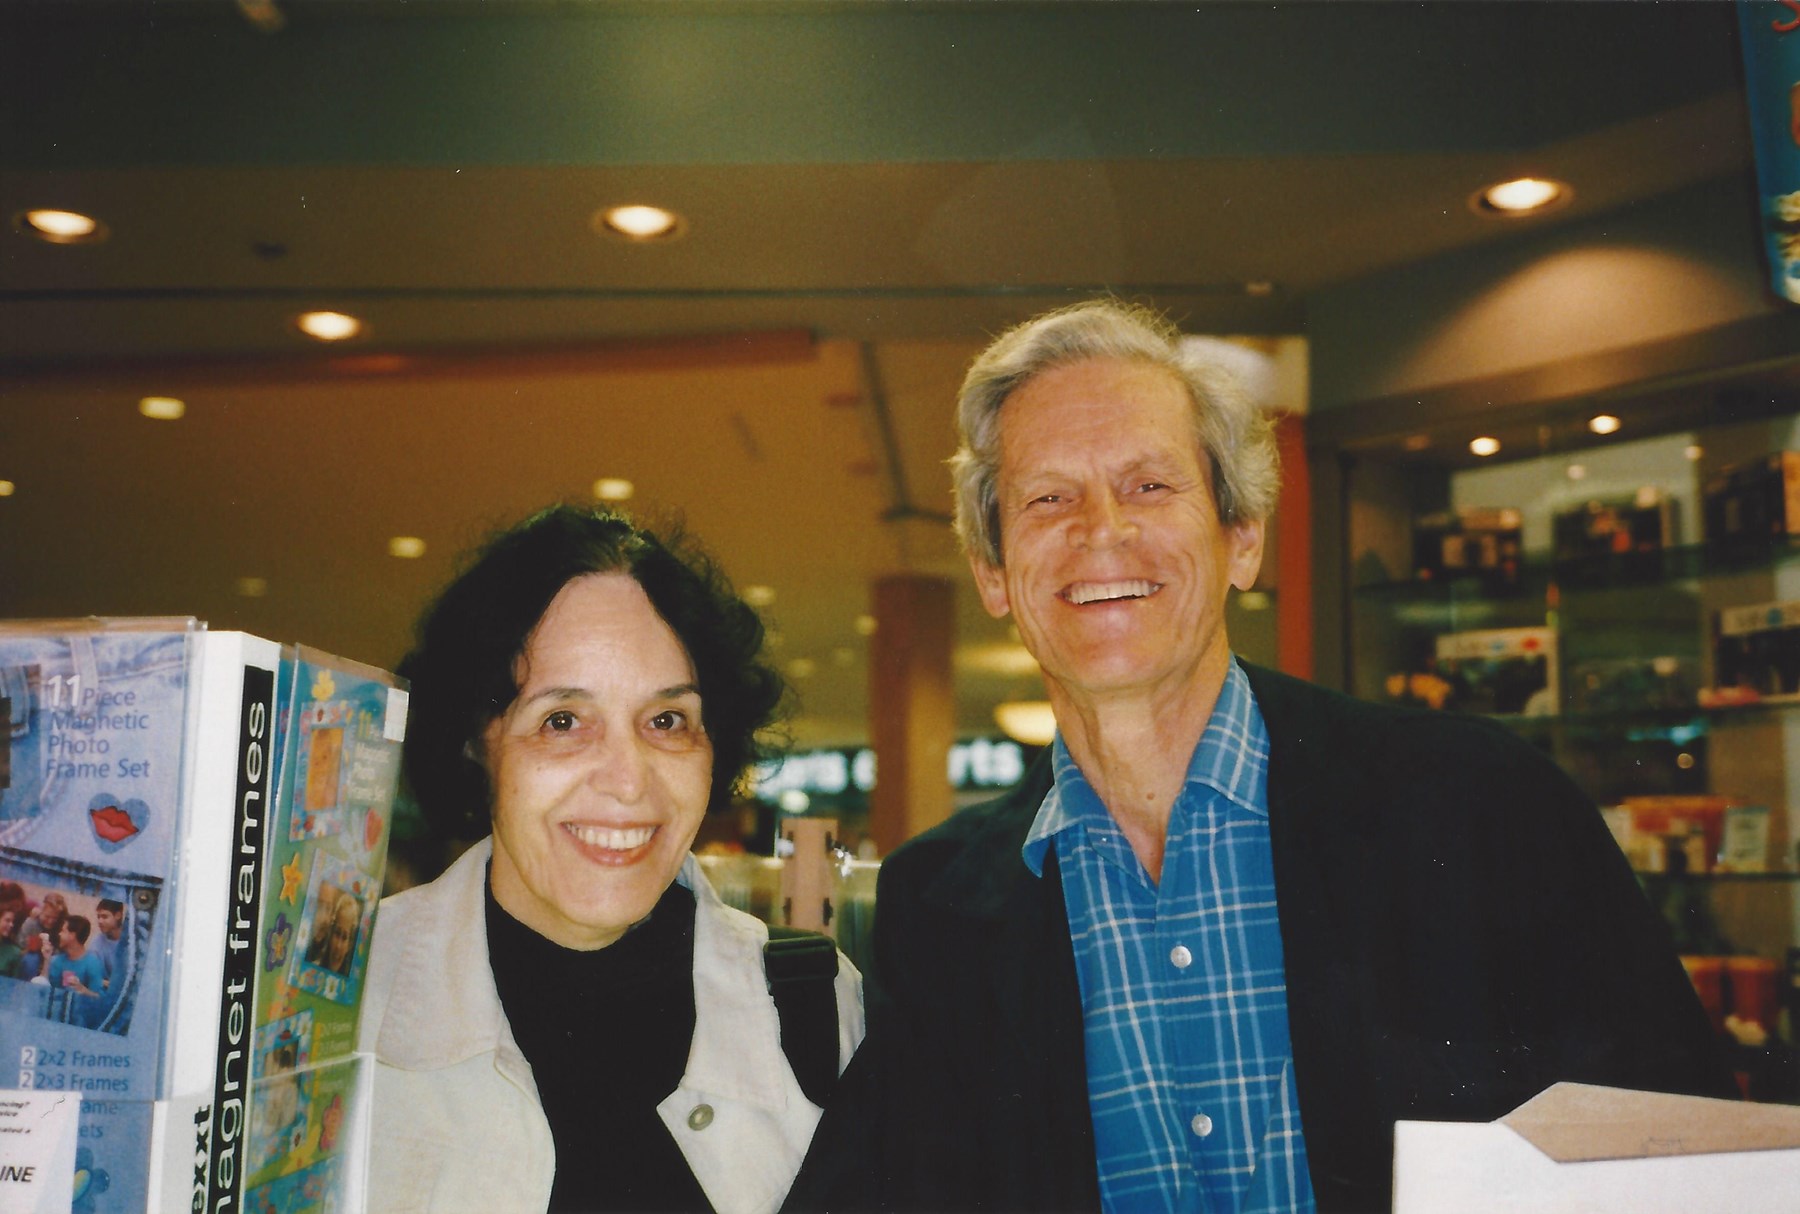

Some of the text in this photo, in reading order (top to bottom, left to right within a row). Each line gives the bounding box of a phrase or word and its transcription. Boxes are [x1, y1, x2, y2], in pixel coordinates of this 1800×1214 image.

[47, 674, 136, 707] 11 Piece
[50, 709, 150, 736] Magnetic
[47, 734, 110, 755] Photo
[46, 758, 151, 779] Frame Set
[229, 701, 265, 956] frames
[22, 1049, 34, 1066] 2
[72, 1050, 131, 1068] Frames
[20, 1072, 33, 1088] 2
[70, 1073, 129, 1091] Frames
[81, 1101, 119, 1116] ame
[79, 1123, 104, 1139] ets
